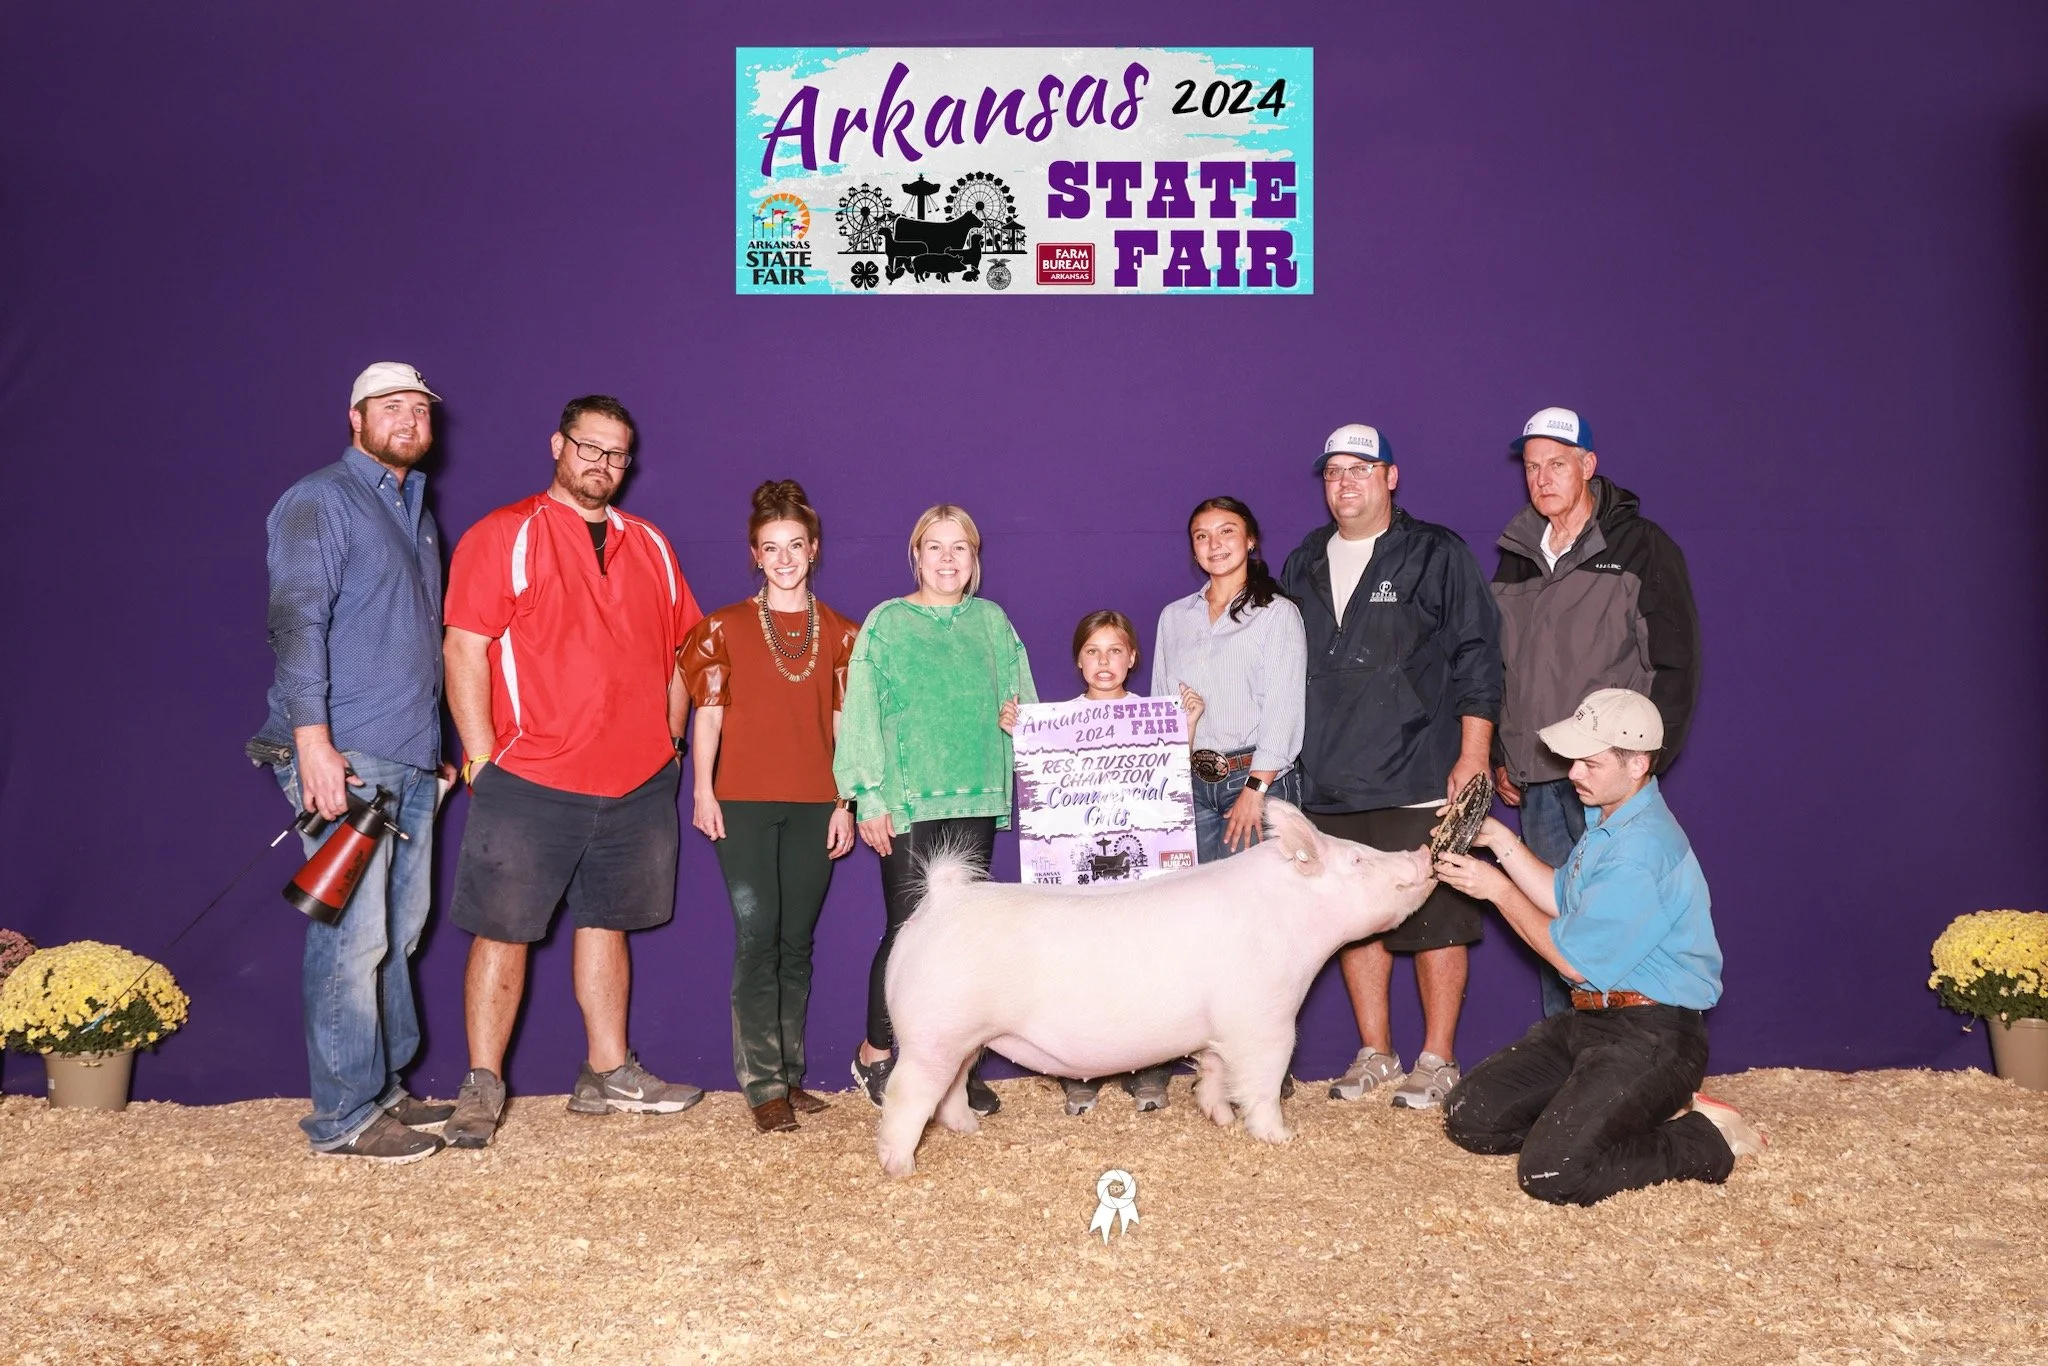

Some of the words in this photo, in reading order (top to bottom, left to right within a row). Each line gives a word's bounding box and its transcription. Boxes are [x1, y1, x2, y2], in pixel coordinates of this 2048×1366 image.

[761, 61, 1149, 177] Arkansas
[1172, 79, 1286, 118] 2024
[1048, 161, 1297, 219] STATE
[748, 241, 810, 249] ARKANSAS
[746, 251, 811, 267] STATE
[1055, 248, 1088, 259] FARM
[1114, 230, 1297, 287] FAIR
[1042, 259, 1089, 270] BUREAU
[753, 269, 806, 285] FAIR
[1022, 704, 1110, 735] Arkansas
[1113, 701, 1178, 719] STATE
[1075, 725, 1115, 743] 2024
[1131, 718, 1179, 735] FAIR
[1042, 758, 1076, 774] RES.
[1082, 752, 1171, 771] DIVISION
[1163, 859, 1192, 868] BUREAU
[1033, 876, 1062, 884] TATE
